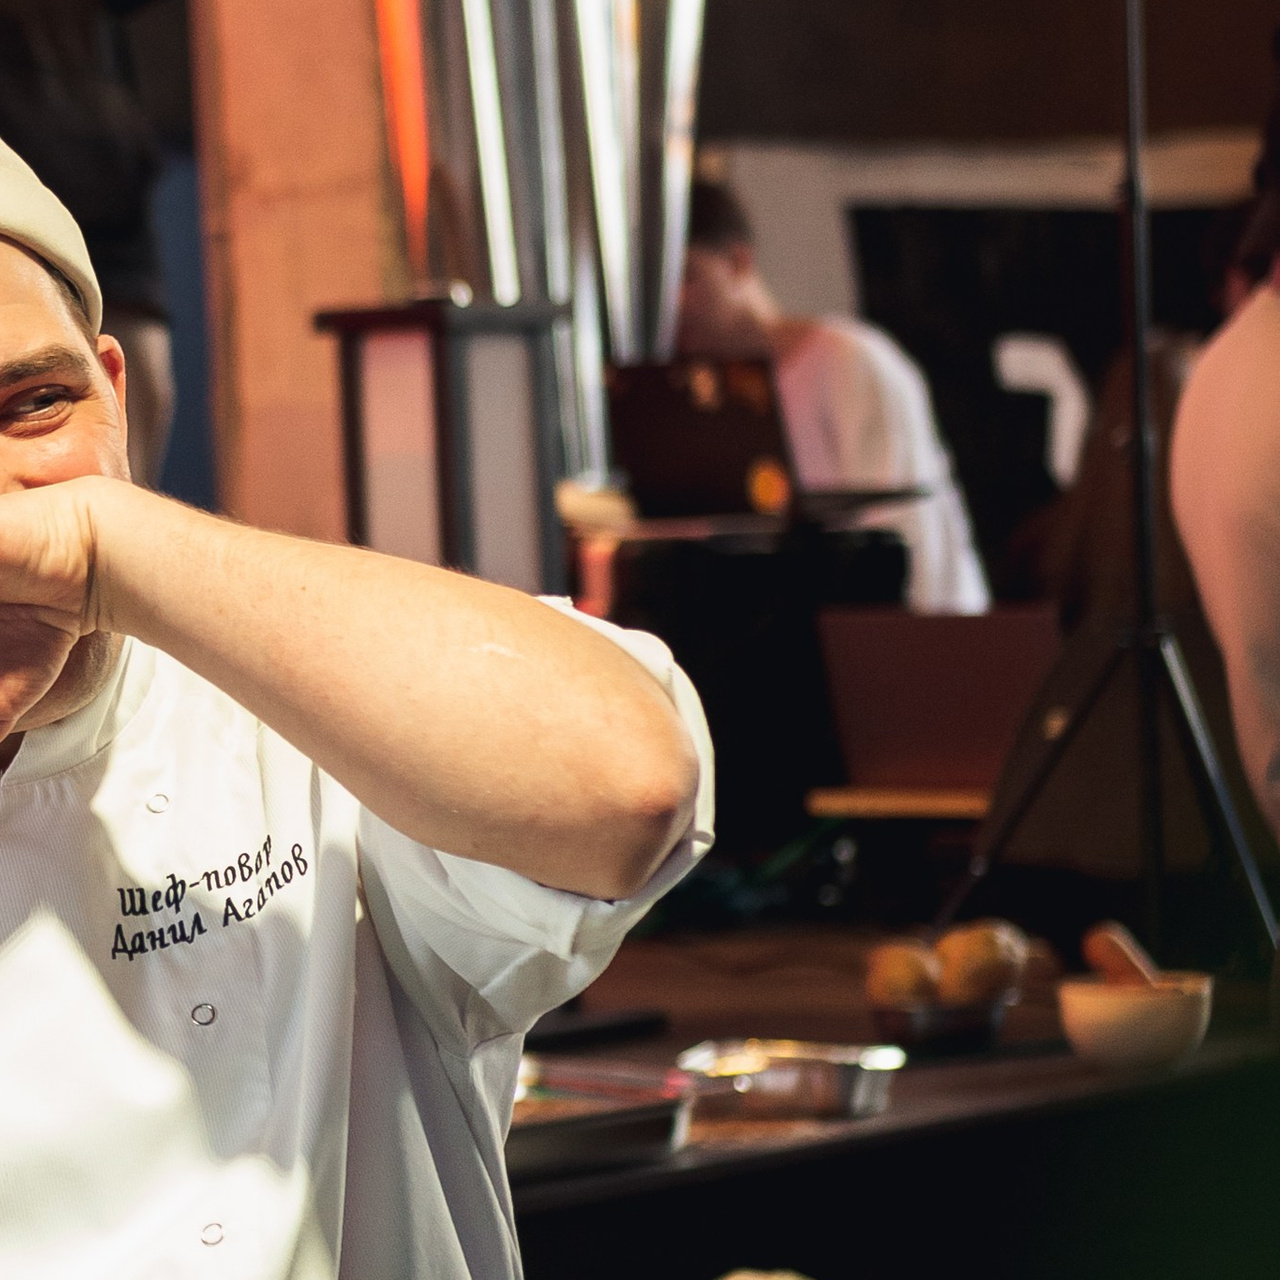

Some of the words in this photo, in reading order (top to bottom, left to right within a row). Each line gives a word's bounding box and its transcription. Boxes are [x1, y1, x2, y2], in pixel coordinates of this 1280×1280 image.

[111, 912, 208, 962] Данил
[222, 843, 309, 928] Агапов
[117, 834, 272, 917] Шеф-повар
